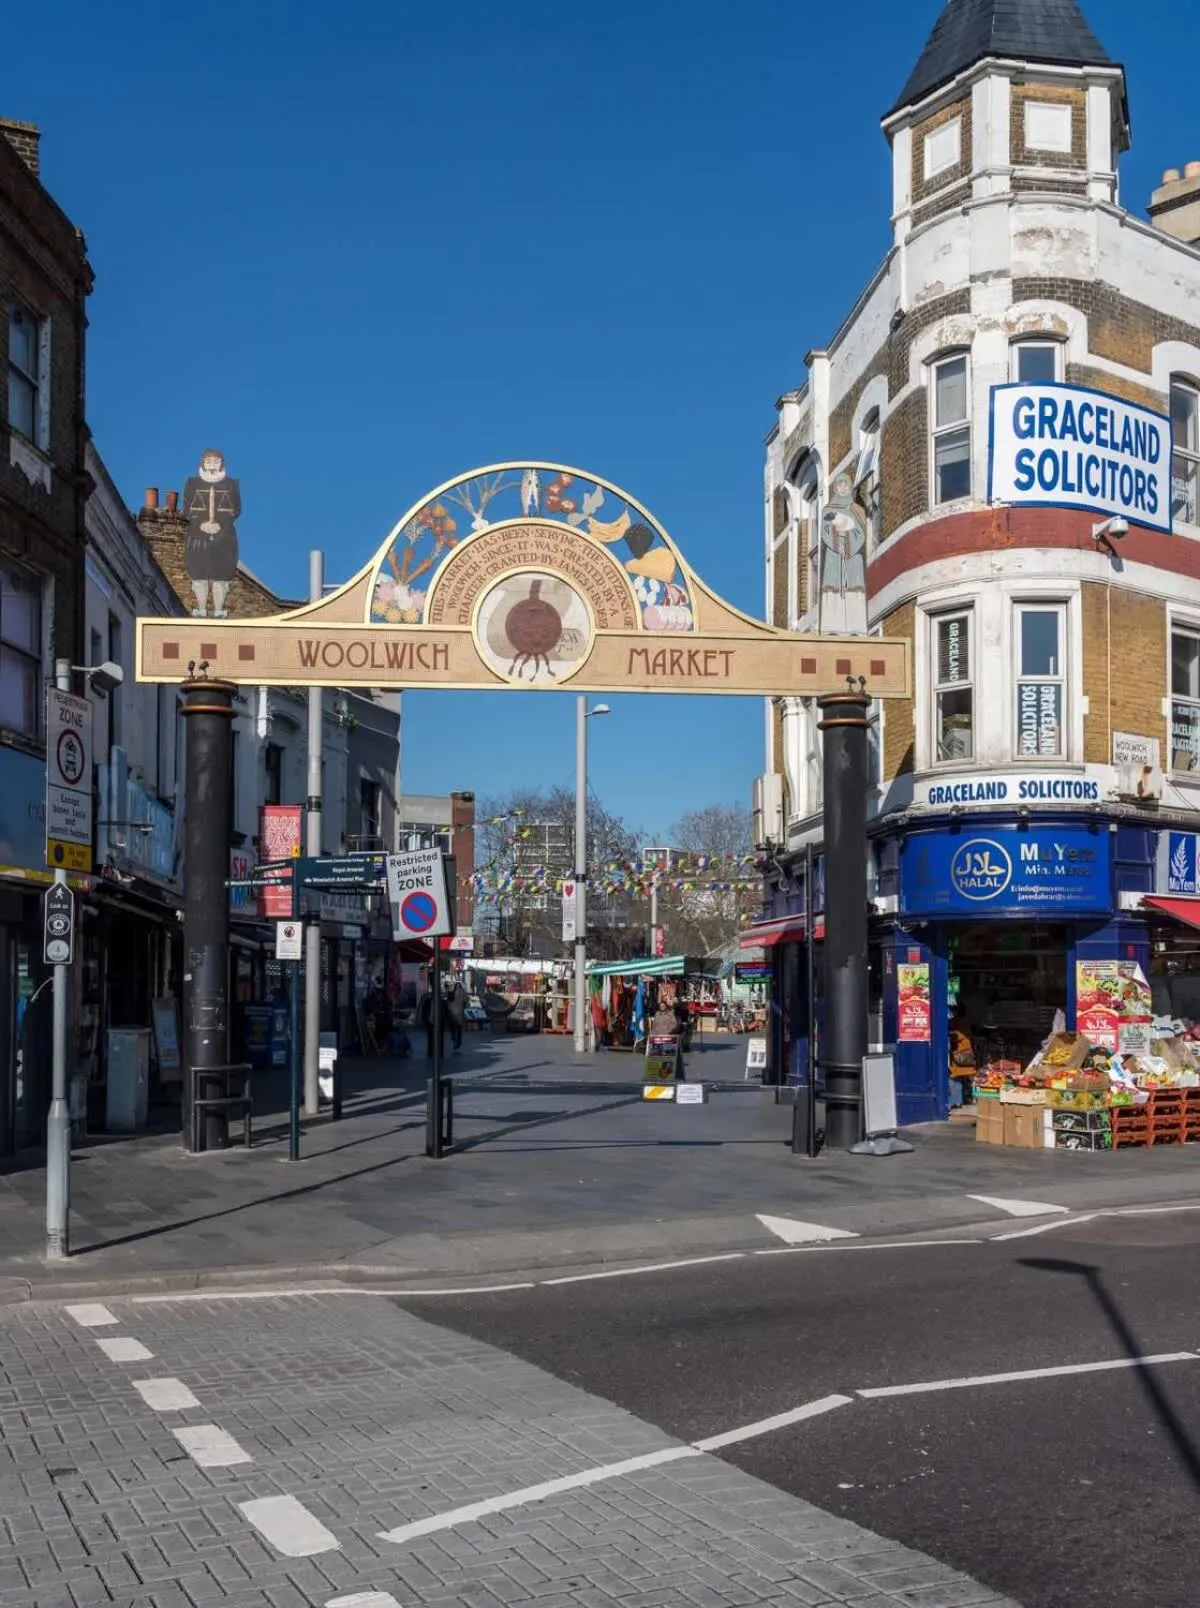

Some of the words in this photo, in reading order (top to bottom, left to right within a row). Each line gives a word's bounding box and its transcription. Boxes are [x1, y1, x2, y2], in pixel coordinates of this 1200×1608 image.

[1012, 396, 1161, 464] GRACELAND
[1013, 448, 1158, 515] SOLICITORS
[482, 543, 513, 563] SINCE
[517, 541, 528, 550] IT
[535, 541, 559, 554] WAS
[432, 599, 445, 624] THIS
[440, 550, 472, 594] MARKET
[475, 535, 498, 553] HAS
[501, 528, 530, 541] BEEN
[534, 529, 577, 547] SERVING
[581, 544, 601, 565] THE
[603, 565, 629, 611] CITIZENS
[624, 616, 633, 627] OF
[563, 548, 606, 586] CREATED
[448, 561, 480, 609] WOOLWICH
[459, 575, 486, 624] CHARTER
[486, 552, 537, 576] GRANTED
[541, 553, 555, 565] BY
[559, 560, 589, 586] JAMES
[603, 588, 614, 602] BY
[608, 608, 619, 616] A
[298, 639, 450, 670] WOOLWICH
[628, 648, 737, 677] MARKET
[949, 622, 959, 682] GRACELAND
[60, 707, 83, 728] ZONE
[1021, 686, 1037, 755] SOLICITORS
[1040, 686, 1056, 755] GRACELAND
[1116, 741, 1148, 752] WOOLWICH
[1115, 752, 1129, 762] NEW
[1131, 754, 1148, 766] ROAD
[928, 782, 1007, 805] GRACELAND
[1019, 780, 1098, 799] SOLICITORS
[390, 852, 438, 867] Restricted
[956, 851, 1006, 876] حلال
[397, 866, 432, 879] parking
[399, 876, 433, 891] ZONE
[960, 877, 1001, 888] HALAL
